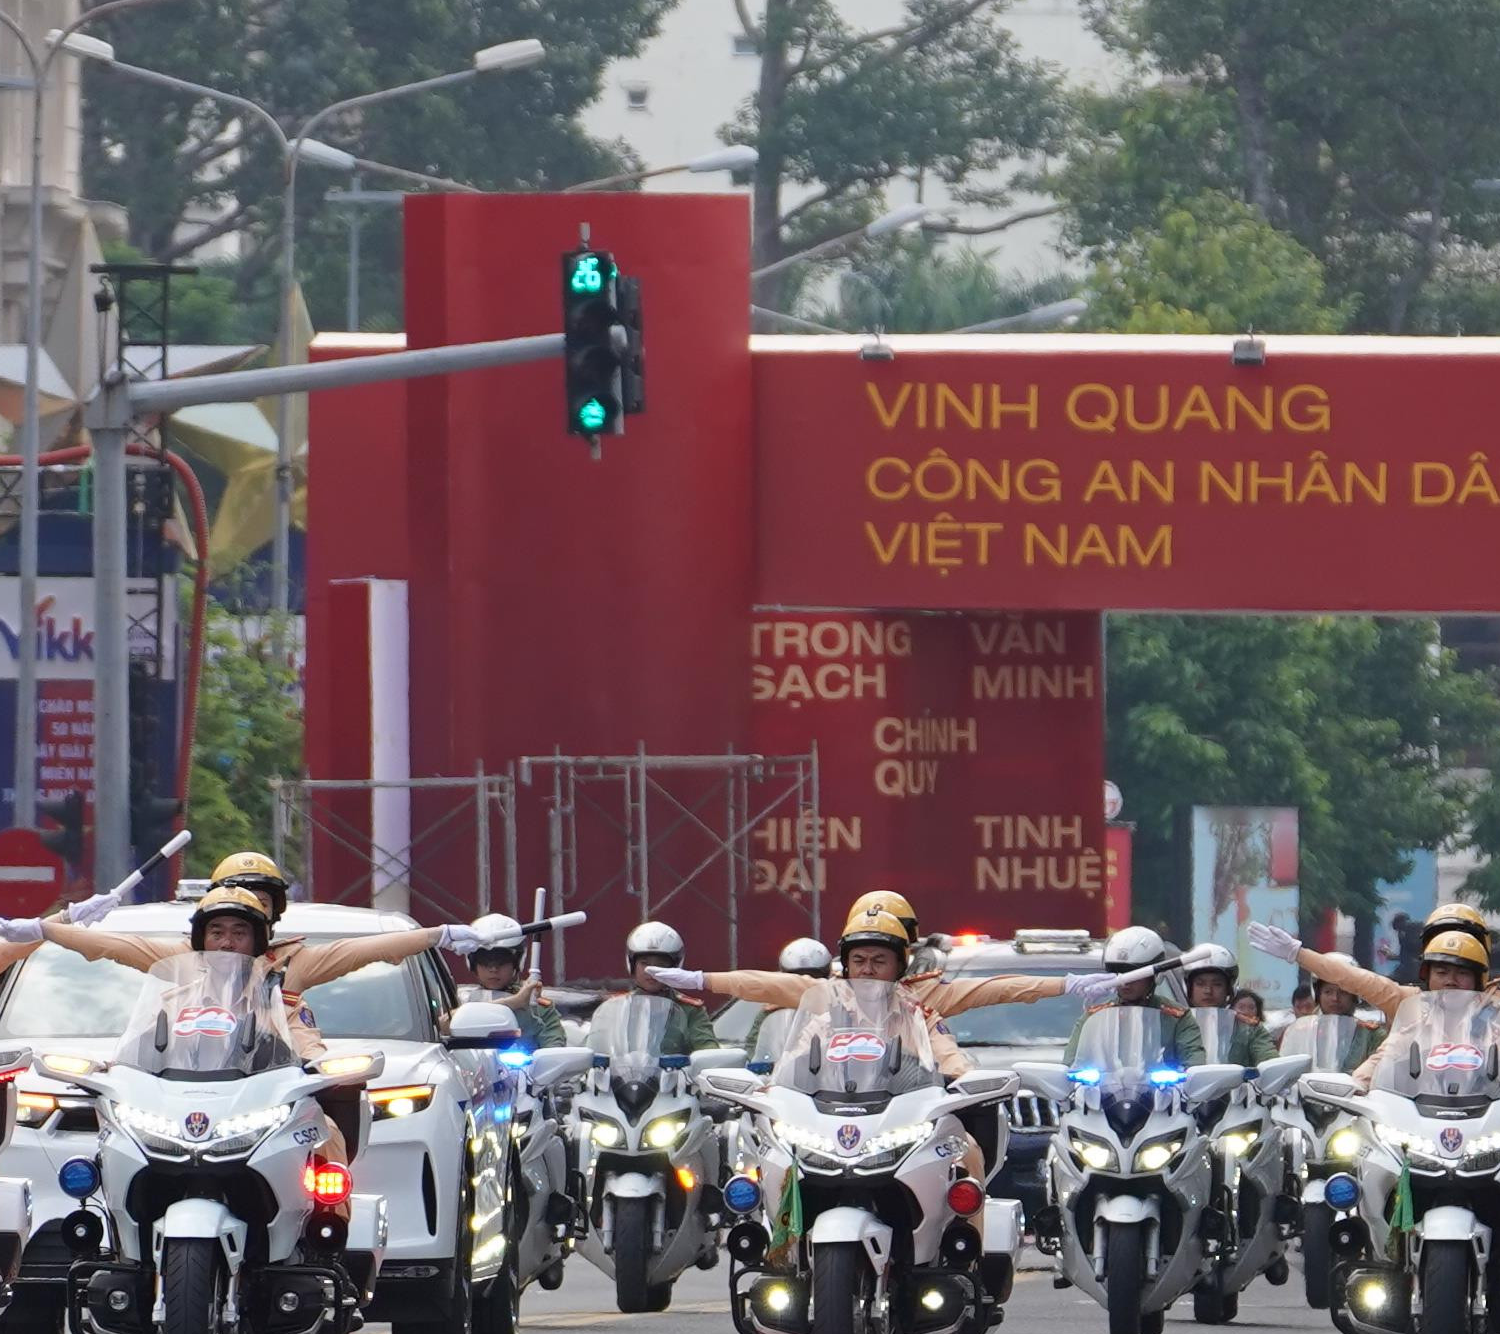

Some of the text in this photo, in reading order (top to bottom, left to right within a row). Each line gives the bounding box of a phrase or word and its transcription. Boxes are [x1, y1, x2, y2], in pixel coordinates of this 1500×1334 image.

[865, 381, 1332, 434] VINH QUANG
[866, 447, 1062, 505] CÔNG
[1083, 459, 1176, 504] AN
[1200, 450, 1388, 506] NHÂN
[865, 512, 1174, 577] VIỆT NAM
[752, 663, 887, 708] SẠCH
[973, 665, 1094, 700] MINH
[874, 707, 978, 754] CHÍNH
[874, 759, 938, 798] QUY
[973, 815, 1083, 849] TINH
[975, 847, 1102, 900] NHUỆ
[292, 1126, 322, 1145] CSGT
